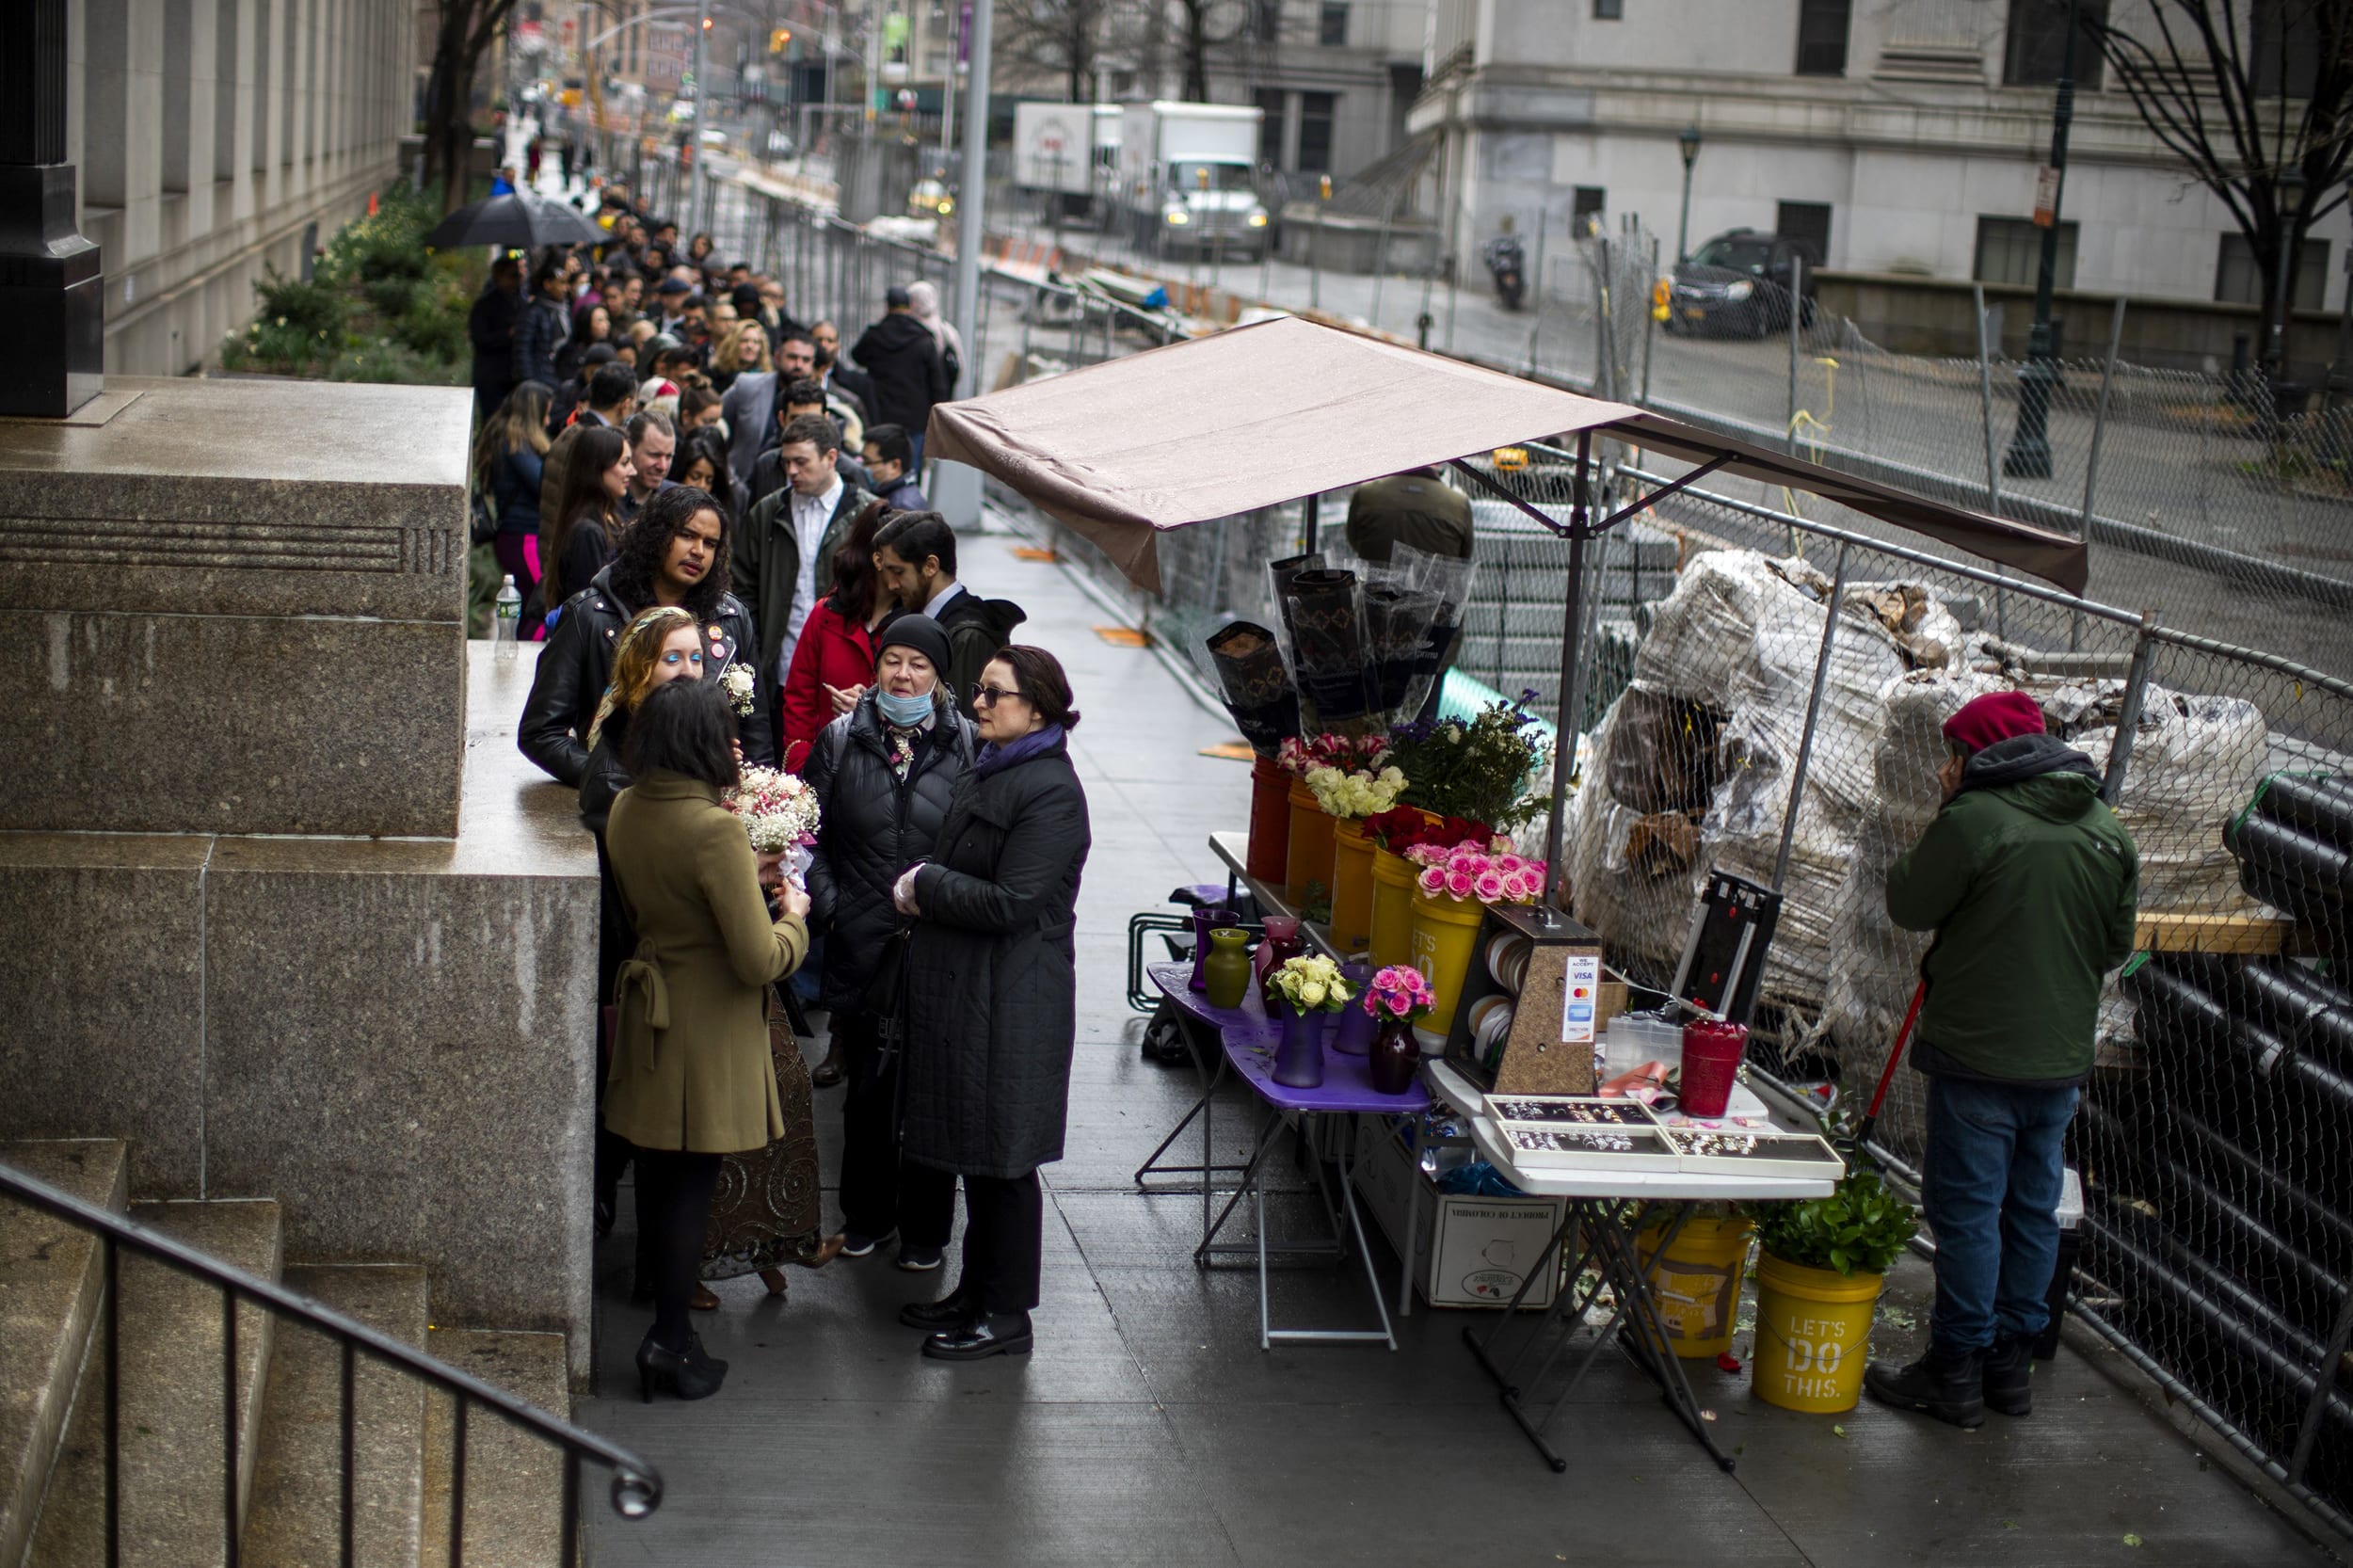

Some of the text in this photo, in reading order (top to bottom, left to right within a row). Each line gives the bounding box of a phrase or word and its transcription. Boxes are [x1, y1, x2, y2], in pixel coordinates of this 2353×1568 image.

[1574, 971, 1593, 980] VISA
[1452, 1208, 1549, 1220] PRODUCT OF COLOMBIA
[1790, 1316, 1846, 1337] LET'S
[1786, 1336, 1842, 1375] DO
[1784, 1373, 1841, 1399] THIS.
